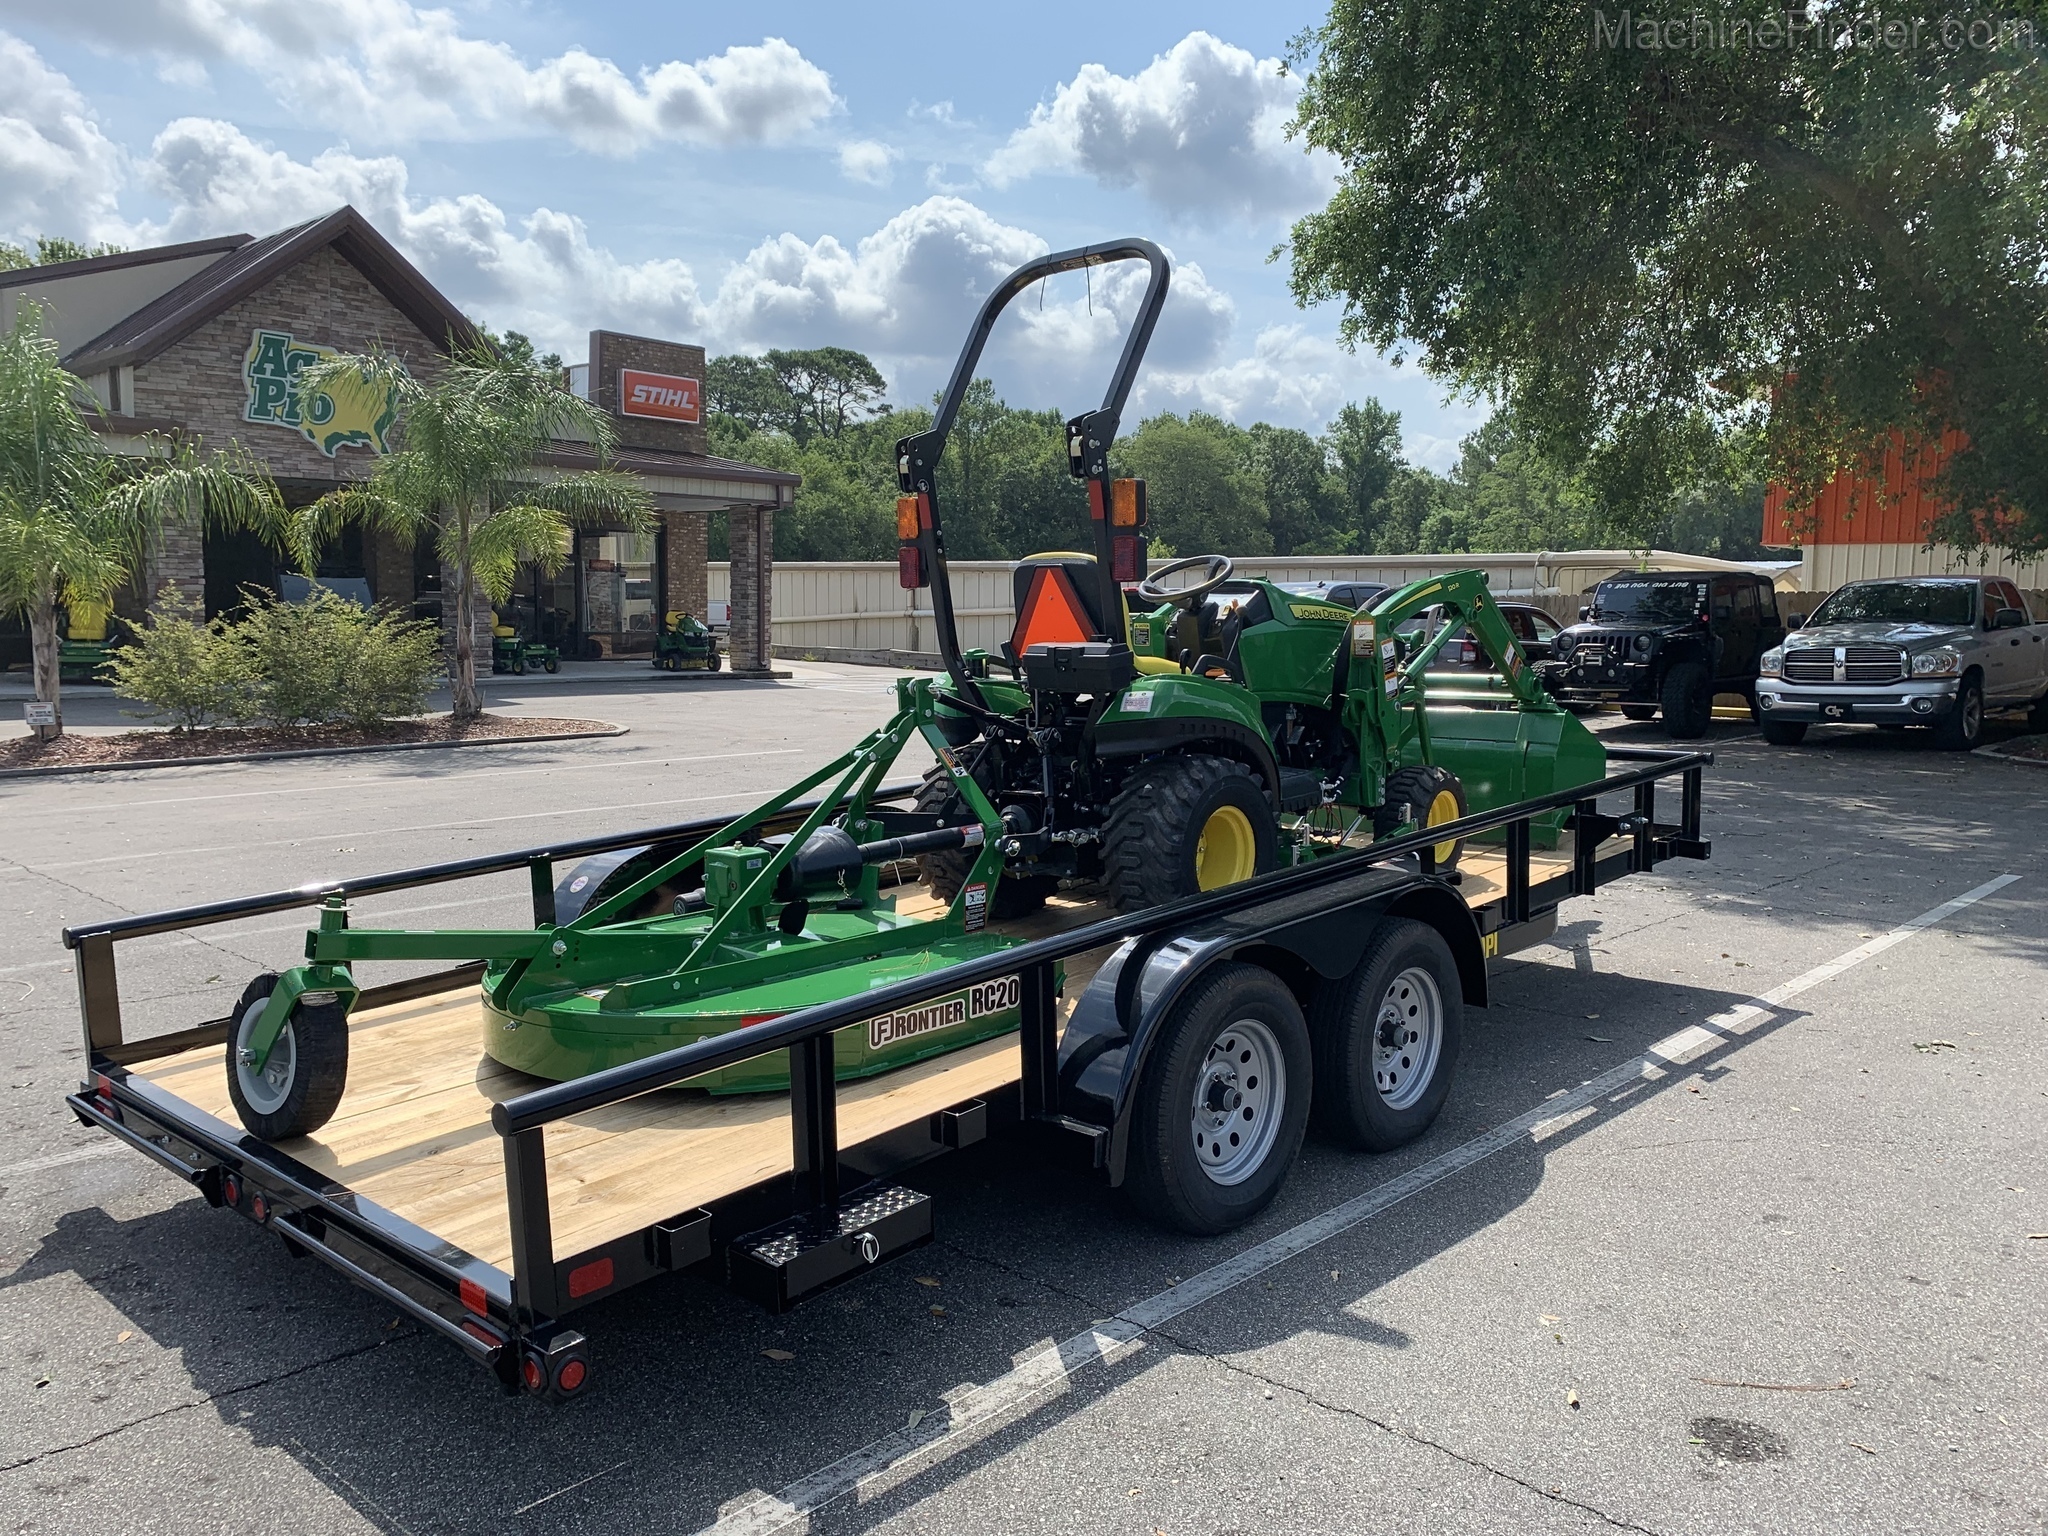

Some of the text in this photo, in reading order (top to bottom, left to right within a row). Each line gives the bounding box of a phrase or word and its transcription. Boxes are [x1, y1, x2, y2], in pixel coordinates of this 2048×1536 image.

[631, 384, 694, 409] STIHL
[1299, 608, 1349, 620] JOHN DEERE
[871, 1000, 964, 1047] FRONTIER
